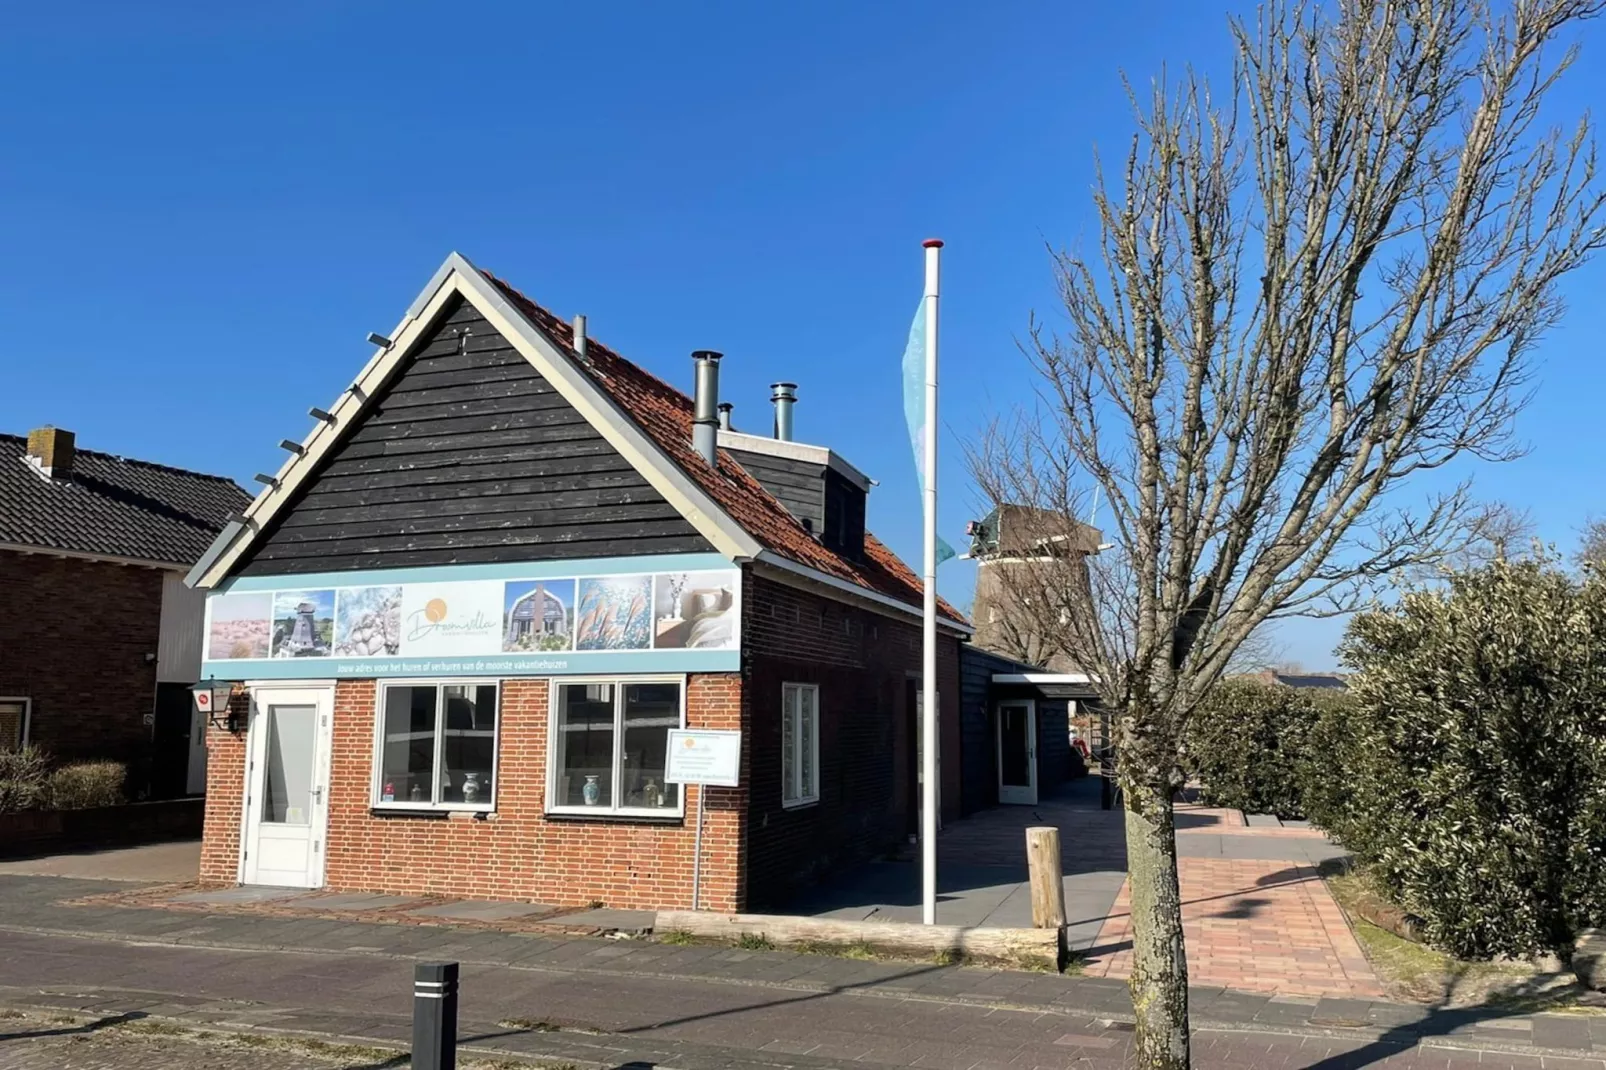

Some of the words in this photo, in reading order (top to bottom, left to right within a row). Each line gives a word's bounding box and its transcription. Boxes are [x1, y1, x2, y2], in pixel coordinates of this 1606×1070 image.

[337, 663, 354, 673] Jouw
[355, 662, 373, 673] adres
[373, 663, 389, 673] voor
[389, 662, 401, 672] het
[402, 662, 421, 672] huren
[422, 661, 431, 671] of
[431, 661, 461, 671] verhuren
[462, 662, 475, 671] van
[475, 660, 484, 671] de
[514, 659, 568, 670] vakantiehuizen
